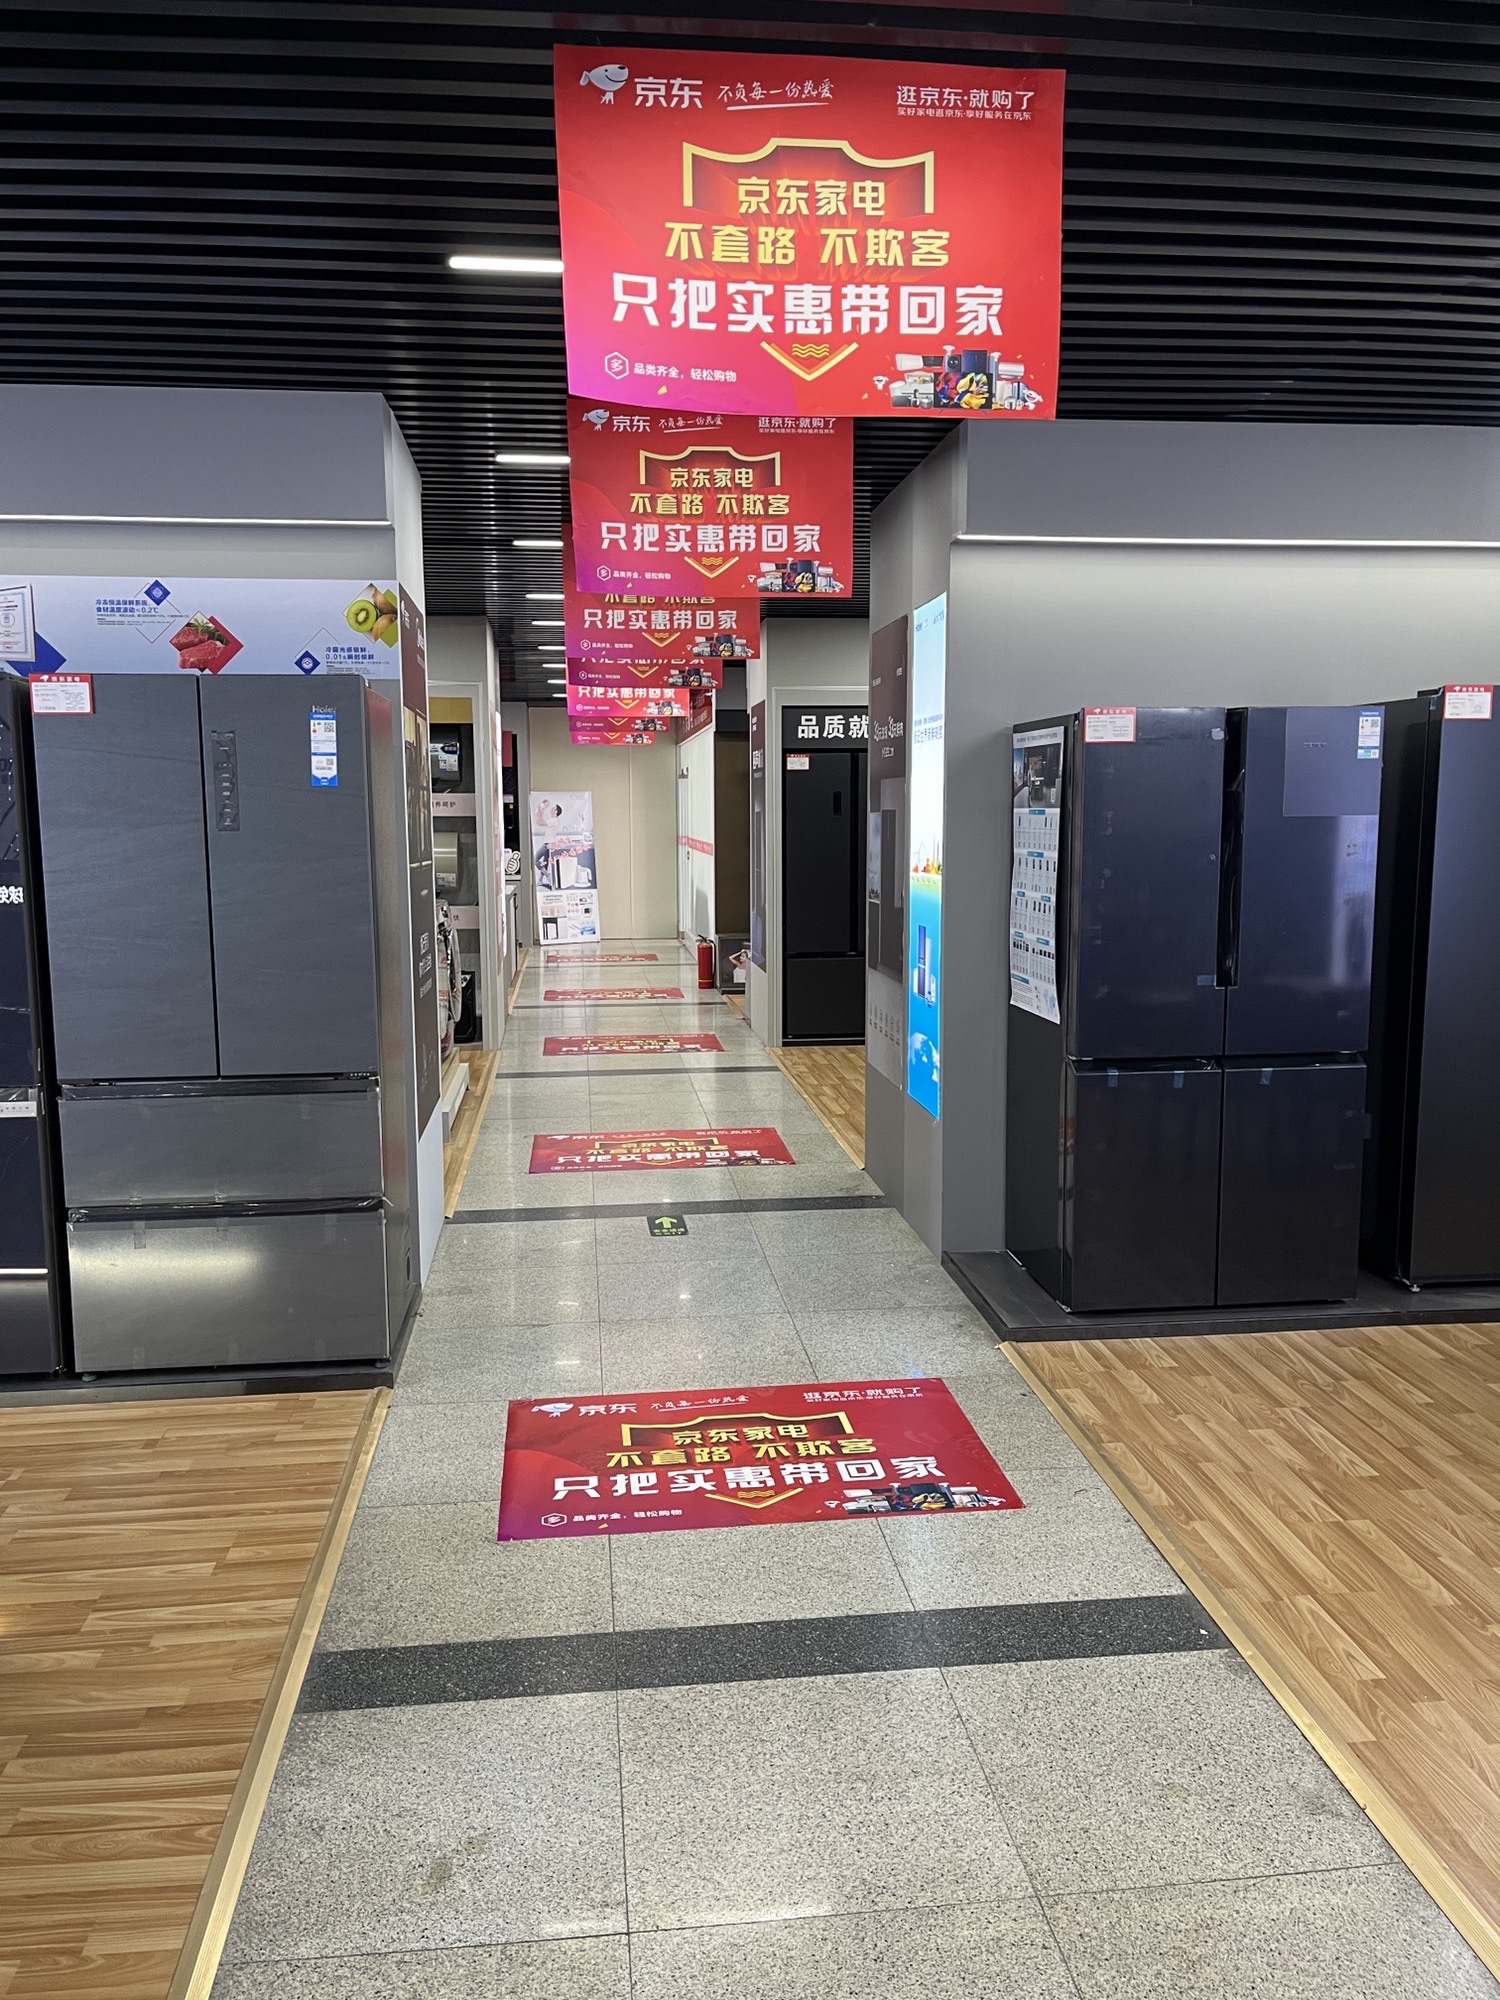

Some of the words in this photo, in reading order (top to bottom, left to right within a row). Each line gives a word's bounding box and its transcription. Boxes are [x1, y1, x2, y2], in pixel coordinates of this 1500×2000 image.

[634, 75, 703, 109] 京东
[717, 78, 835, 102] 不负每一份热爱
[896, 85, 1035, 110] 逛京东·就购了
[737, 176, 886, 217] 京东家电
[665, 222, 796, 265] 不套路
[820, 228, 951, 267] 不欺客
[612, 272, 1004, 336] 只把实惠带回家
[634, 362, 737, 382] 品类齐全，轻松购物
[612, 415, 651, 432] 京东
[758, 416, 837, 428] 逛京东·就购了
[670, 468, 754, 488] 京东家电
[630, 493, 704, 515] 不套路
[716, 494, 790, 515] 不欺客
[601, 522, 821, 552] 只把实惠带回家
[583, 609, 737, 630] 只把实惠带回家
[797, 714, 869, 739] 品质就
[803, 1386, 921, 1400] 逛京东·就购了
[578, 1403, 638, 1417] 京东
[671, 1424, 809, 1446] 京东家电
[606, 1446, 731, 1468] 不套路
[752, 1438, 877, 1459] 不欺客
[552, 1456, 946, 1500] 只把实惠带回家
